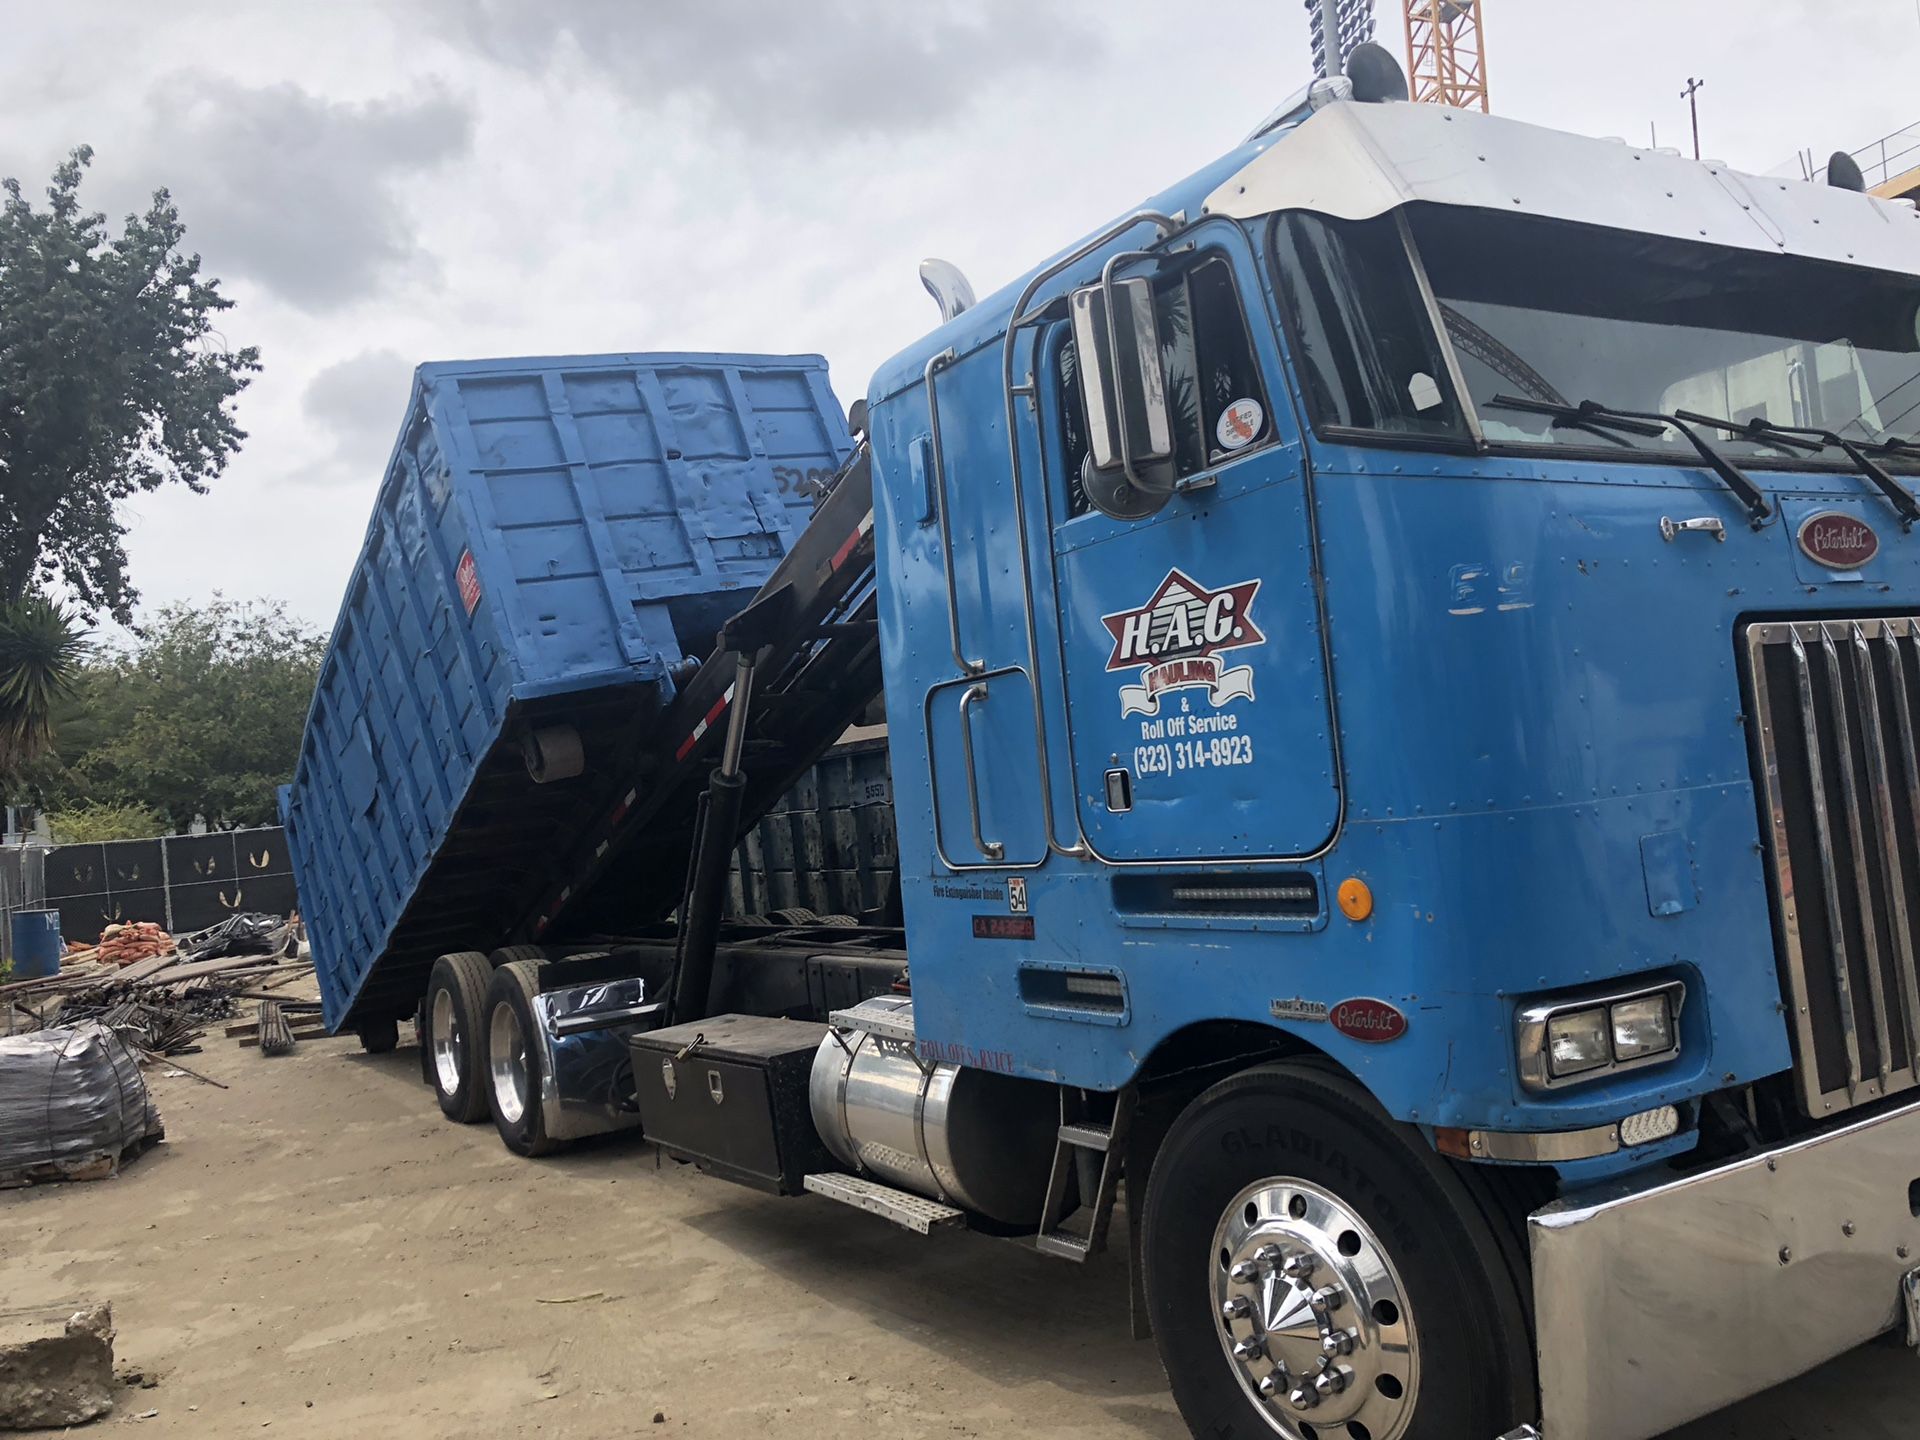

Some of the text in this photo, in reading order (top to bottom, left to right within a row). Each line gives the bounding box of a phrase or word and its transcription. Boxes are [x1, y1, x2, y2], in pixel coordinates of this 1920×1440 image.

[1814, 524, 1868, 552] Peterbilt
[1119, 593, 1244, 660] H.A.G.
[1148, 660, 1216, 692] HAULING
[1181, 697, 1190, 712] &
[1141, 712, 1237, 740] Roll Off Service
[1134, 735, 1254, 779] (323) 314-8923
[933, 885, 944, 897] Fire
[983, 887, 1004, 900] Inside
[1011, 886, 1025, 909] 54
[1338, 1005, 1398, 1031] Peterbilt
[1220, 1124, 1421, 1254] GLADIATOR
